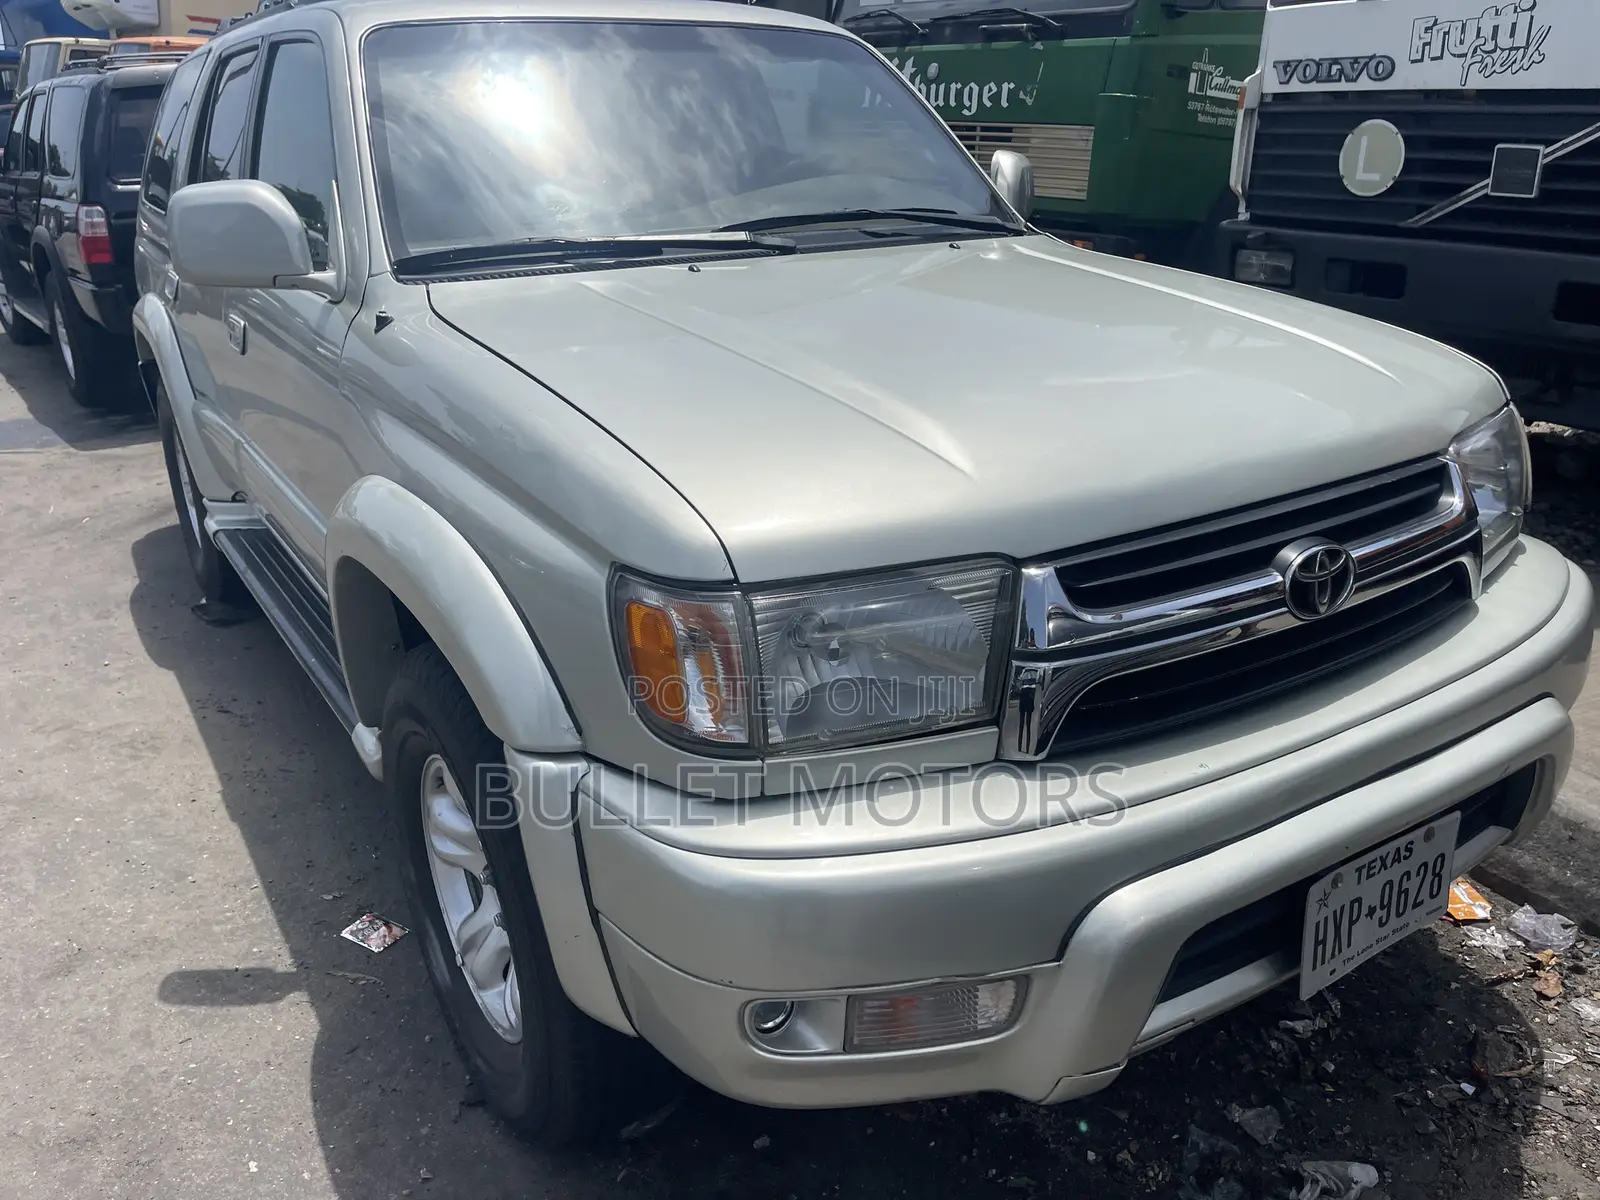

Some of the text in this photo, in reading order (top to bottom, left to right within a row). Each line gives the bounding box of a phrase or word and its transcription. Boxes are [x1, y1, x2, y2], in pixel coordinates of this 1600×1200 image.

[1409, 0, 1537, 63] Frutti
[1273, 54, 1396, 85] VOLVO
[1355, 135, 1380, 181] L
[1354, 840, 1415, 886] TEXAS
[1311, 852, 1446, 972] HXP 9628
[1342, 954, 1356, 967] The
[1375, 932, 1391, 946] Star
[1391, 922, 1410, 936] State
